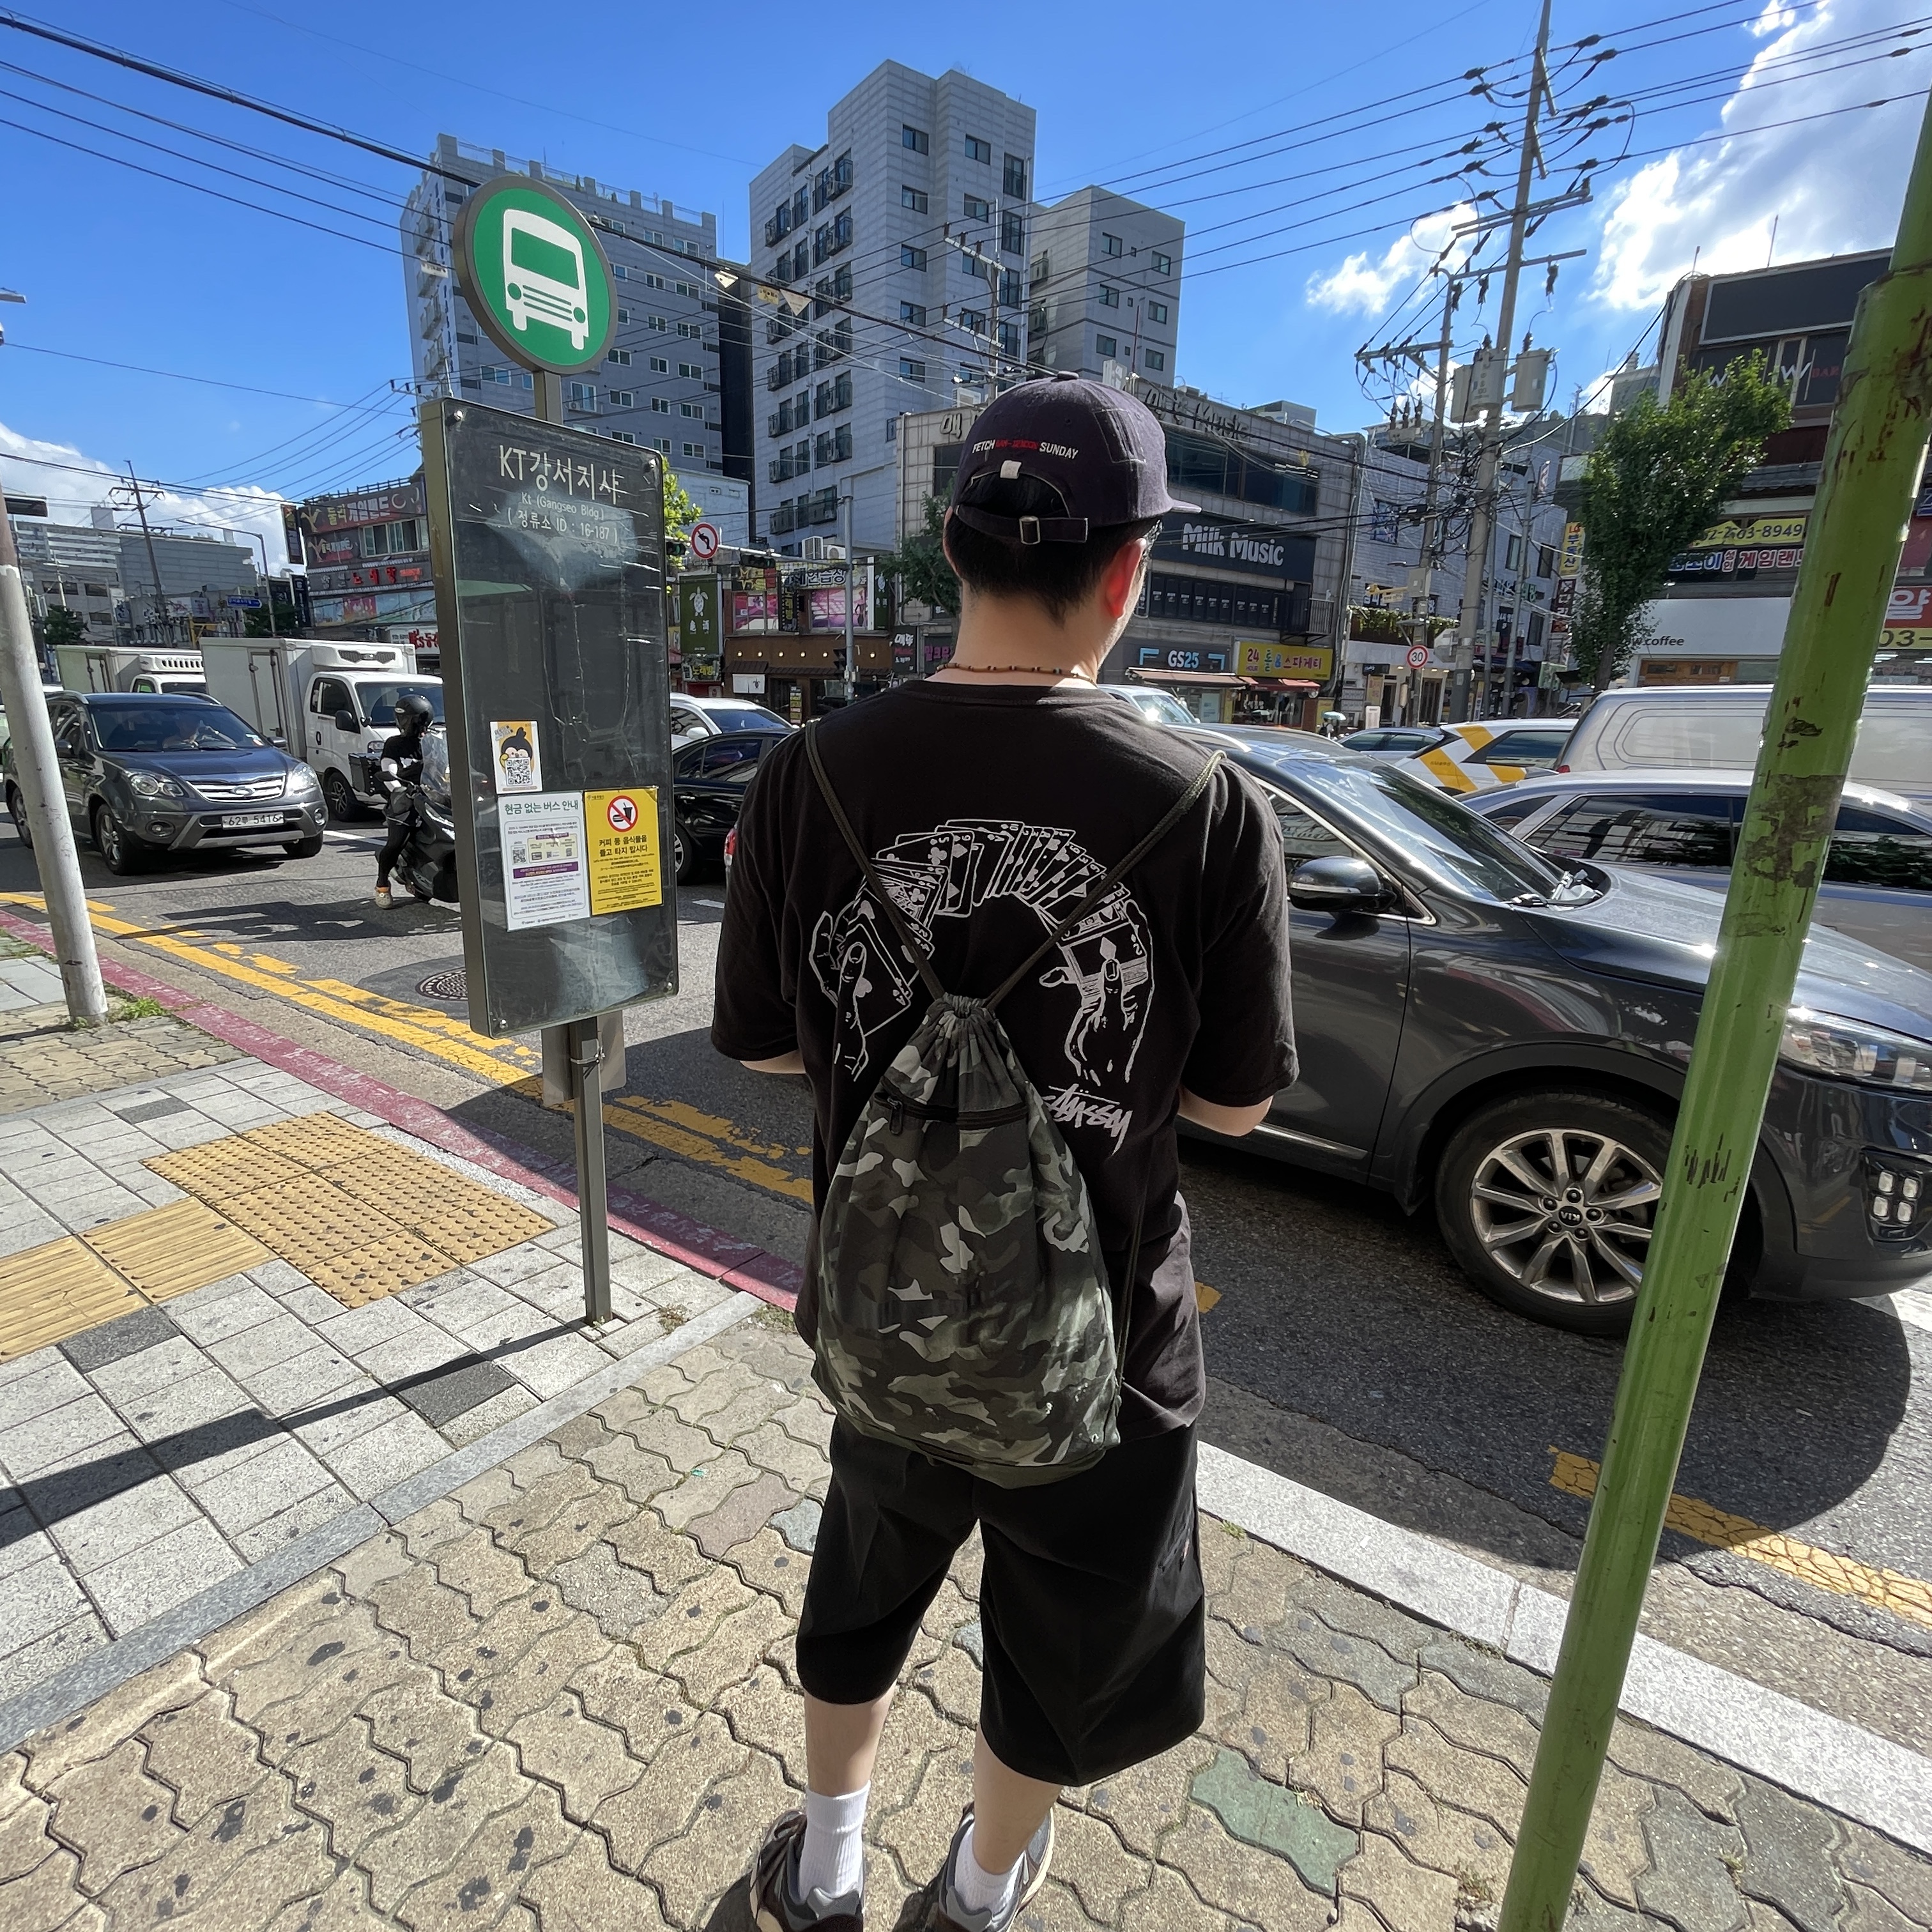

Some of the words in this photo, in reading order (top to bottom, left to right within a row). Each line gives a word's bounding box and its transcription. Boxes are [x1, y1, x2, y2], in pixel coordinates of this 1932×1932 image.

[972, 440, 995, 454] FETCH
[1039, 442, 1078, 459] SUNDAY
[537, 494, 576, 514] (Gangseo
[518, 510, 551, 530] 정류소
[556, 518, 567, 532] ID
[580, 522, 610, 540] 16-187
[1183, 523, 1225, 556] Milk
[1230, 532, 1284, 566] Music
[1168, 650, 1200, 669] GS25
[1247, 648, 1259, 663] 24
[1411, 652, 1423, 663] 30
[505, 803, 523, 815] 현금
[524, 802, 542, 814] 없는
[543, 801, 561, 811] 버스
[562, 800, 579, 811] 안내
[254, 815, 278, 824] 5416
[599, 838, 611, 847] 커피
[615, 847, 628, 855] 타지
[1560, 1210, 1581, 1222] KIA
